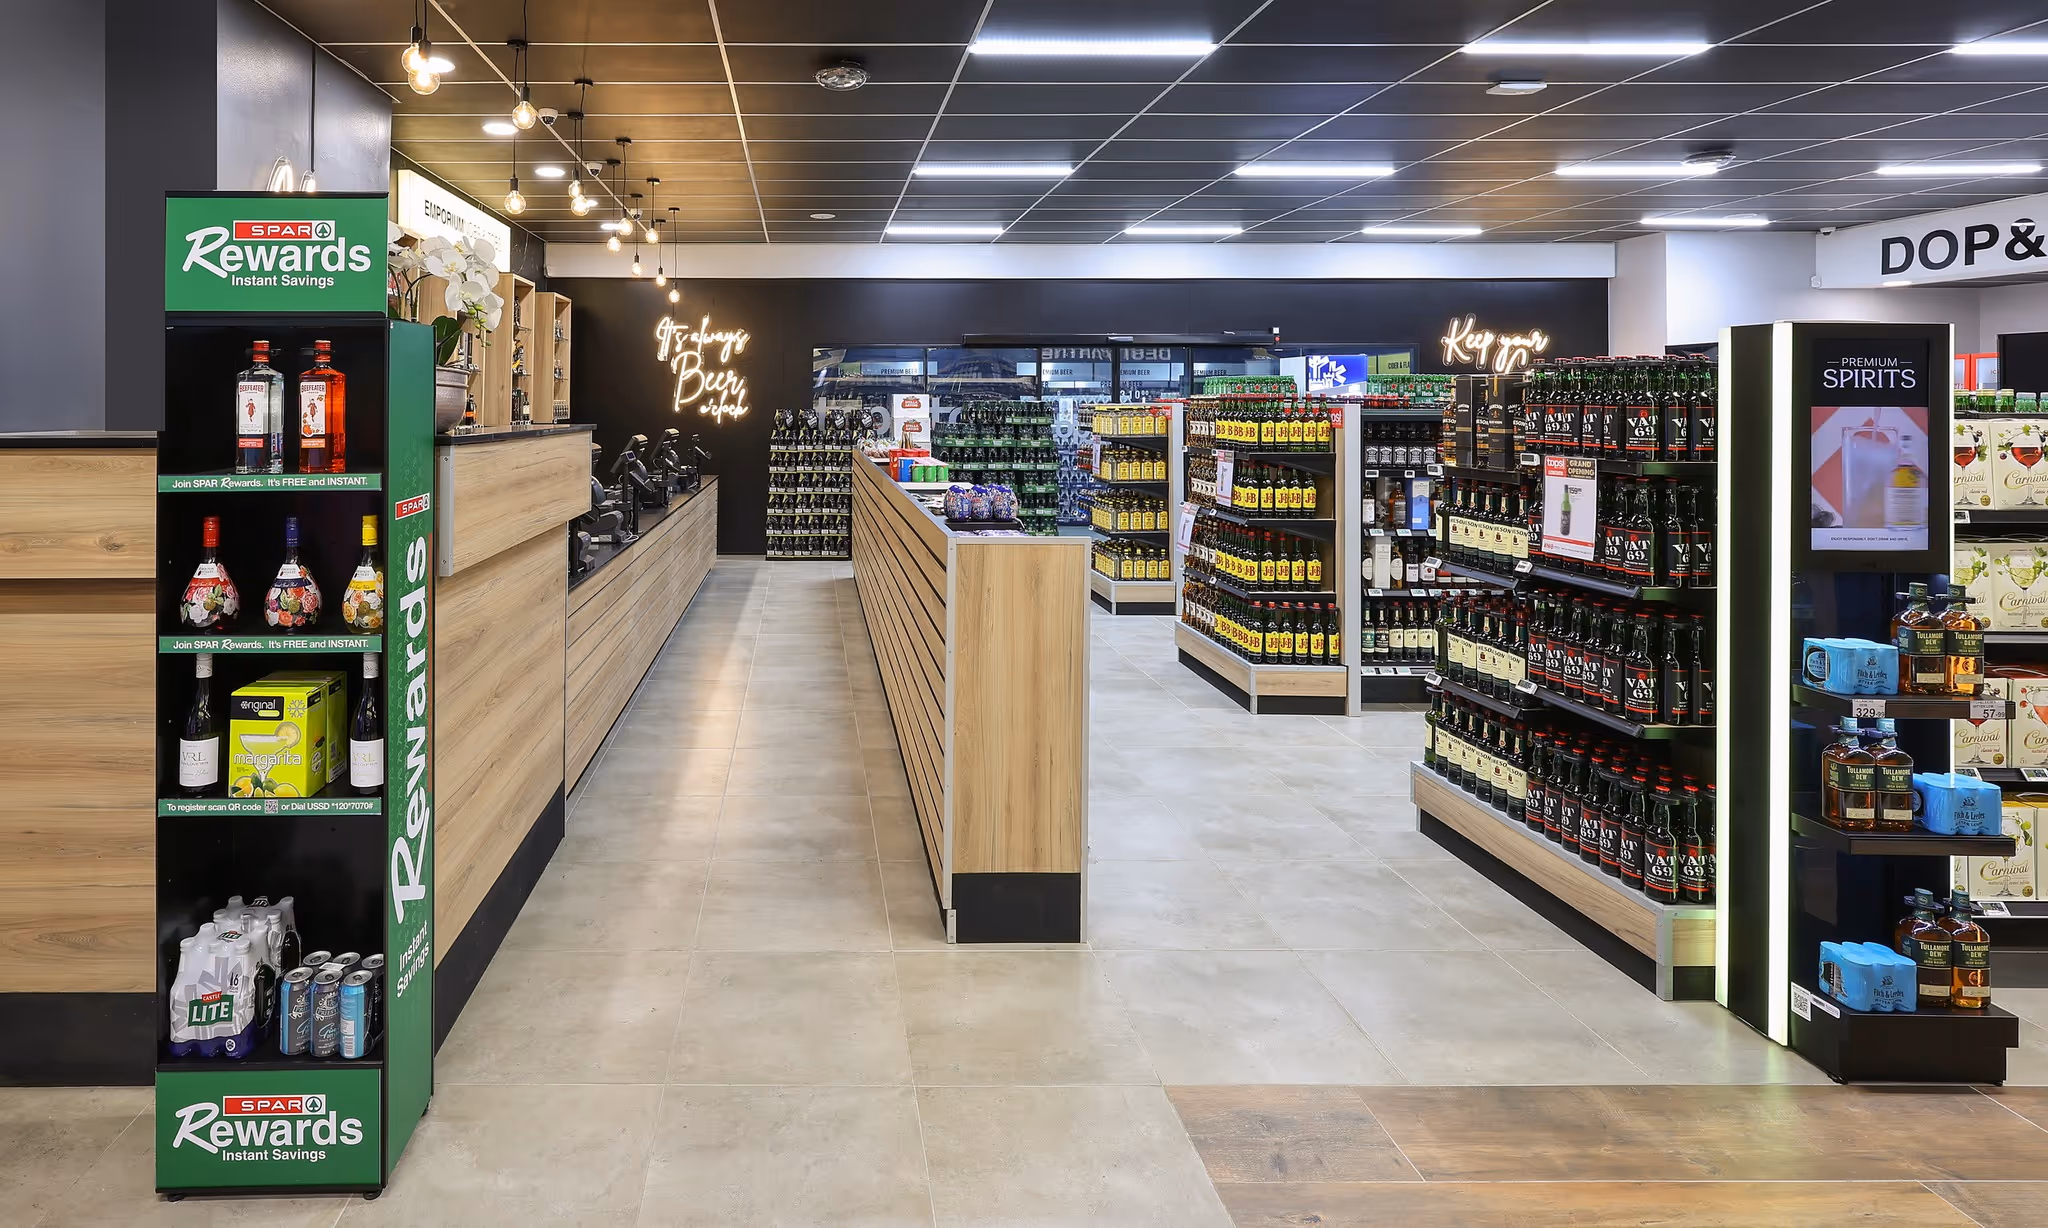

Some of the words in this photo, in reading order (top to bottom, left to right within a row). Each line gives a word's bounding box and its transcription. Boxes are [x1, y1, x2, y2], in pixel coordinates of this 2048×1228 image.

[424, 199, 465, 234] EMPORIUM
[251, 225, 312, 236] SPAR
[182, 226, 371, 278] Rewards
[231, 274, 277, 287] Instant
[281, 274, 334, 289] Savings
[690, 311, 750, 364] always
[1441, 313, 1494, 370] Keep
[1492, 328, 1550, 374] your
[1841, 357, 1898, 367] PREMIUM
[880, 368, 904, 376] PREMIUM
[671, 351, 745, 412] Beer
[1823, 368, 1917, 389] SPIRITS
[239, 384, 265, 393] BEEFEATER
[301, 384, 326, 393] BEEFEATER
[1525, 412, 1541, 422] AT
[1628, 416, 1659, 427] VAT
[1567, 468, 1595, 476] OPENING
[172, 479, 192, 490] Join
[193, 479, 218, 489] SPAR
[220, 477, 264, 489] Rewards.
[267, 478, 281, 487] It's
[282, 478, 307, 487] FREE
[308, 477, 326, 487] and
[327, 477, 368, 487] INSTANT.
[2004, 470, 2048, 489] Carniva
[402, 500, 423, 514] SPAR
[1606, 537, 1623, 546] AT
[1916, 631, 1944, 640] TULLAMORE
[1954, 632, 1983, 640] TULLAMORE
[173, 641, 192, 650] Join
[194, 640, 219, 649] SPAR
[221, 639, 264, 651] Rewards.
[269, 640, 282, 649] It's
[283, 640, 308, 649] FREE
[309, 639, 326, 648] and
[328, 639, 369, 648] INSTANT.
[1583, 662, 1600, 672] AT
[1868, 670, 1873, 679] &
[1626, 677, 1657, 689] VAT
[392, 536, 431, 924] Rewards
[1955, 729, 2001, 749] Carnival
[233, 749, 302, 769] margarita
[1846, 766, 1874, 775] TULLAMORE
[1882, 767, 1911, 775] TULLAMORE
[1527, 789, 1543, 799] AT
[167, 803, 177, 811] To
[178, 803, 207, 813] register
[228, 803, 241, 812] QR
[242, 803, 262, 811] code
[291, 802, 306, 811] Dial
[307, 802, 330, 811] USSD
[1965, 812, 1970, 820] &
[1600, 828, 1617, 839] AT
[1620, 839, 1638, 850] AT
[1645, 852, 1677, 866] VAT
[1679, 852, 1709, 866] VAT
[1980, 860, 2029, 881] Carnival
[400, 920, 428, 972] Instant
[1919, 942, 1950, 952] TULLAMORE
[1961, 943, 1989, 951] TULLAMORE
[397, 941, 429, 998] Savings
[230, 972, 239, 986] 16
[202, 993, 221, 1002] CASTLE
[1885, 989, 1889, 998] &
[192, 1002, 230, 1024] LITE
[241, 1100, 302, 1112] SPAR
[173, 1102, 364, 1154] Rewards
[222, 1150, 268, 1161] Instant
[272, 1149, 327, 1163] Savings
